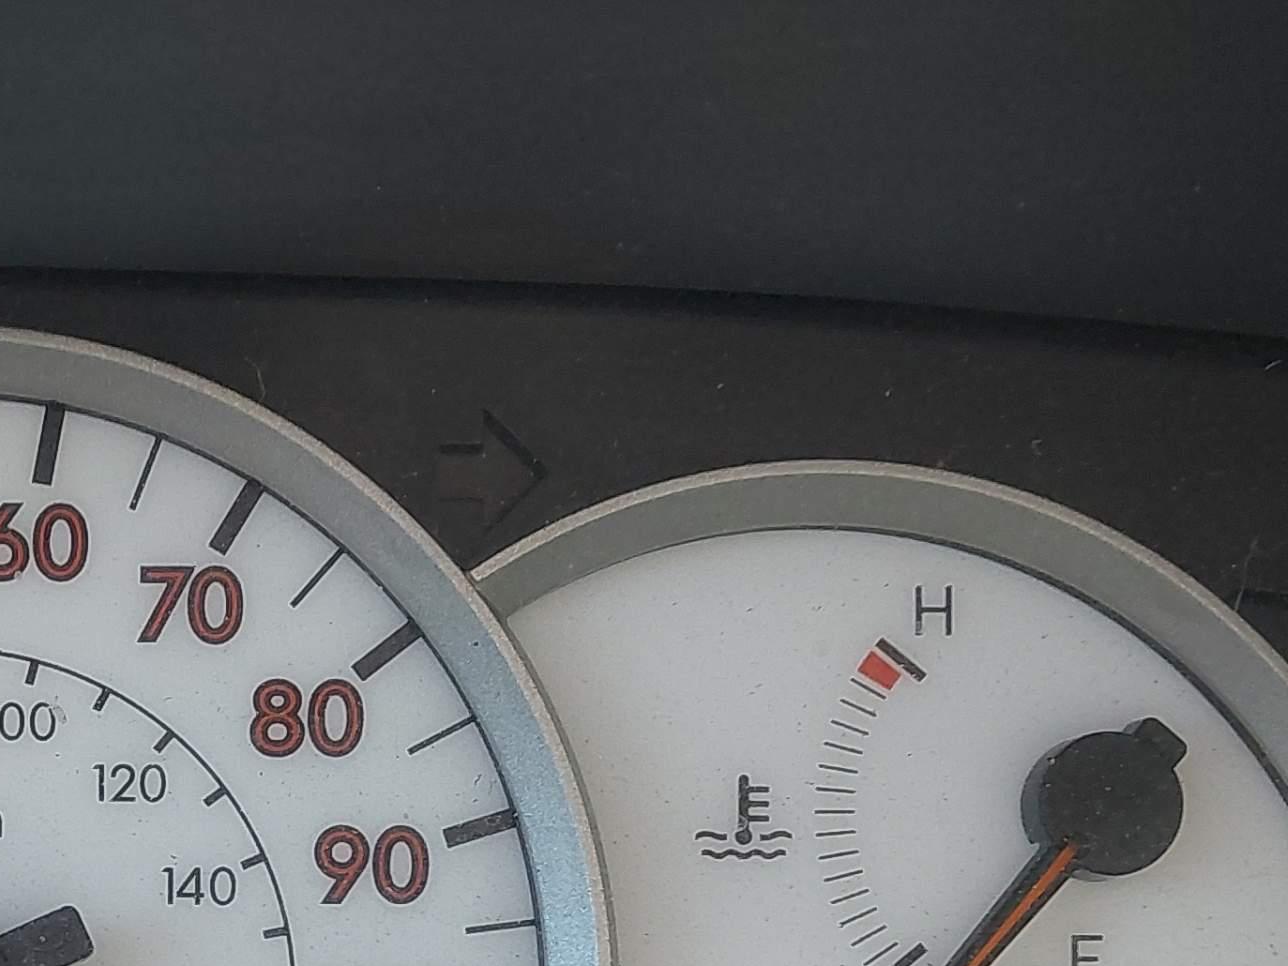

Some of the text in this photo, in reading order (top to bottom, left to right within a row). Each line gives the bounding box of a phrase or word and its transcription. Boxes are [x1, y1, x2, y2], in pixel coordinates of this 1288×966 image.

[137, 565, 243, 645] 70
[915, 586, 952, 635] H
[250, 679, 363, 757] 80
[93, 764, 166, 802] 120
[162, 867, 236, 905] 140
[314, 825, 429, 904] 90
